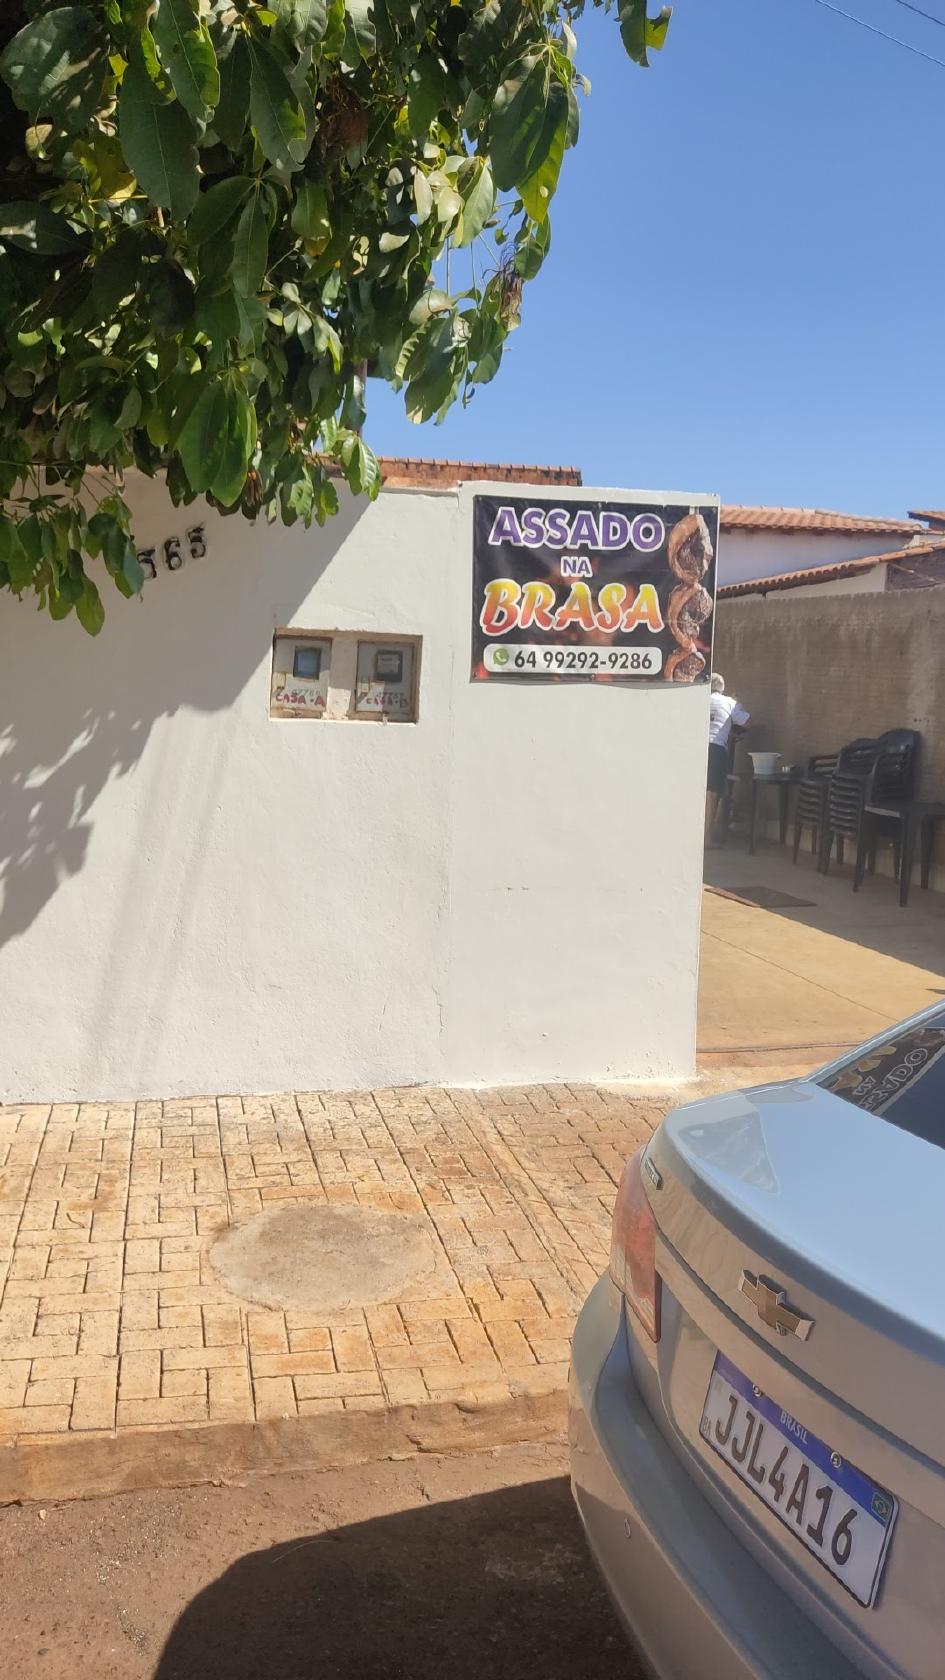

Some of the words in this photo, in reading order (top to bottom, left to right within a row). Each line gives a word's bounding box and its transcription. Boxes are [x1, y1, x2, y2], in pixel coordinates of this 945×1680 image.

[488, 507, 665, 552] ASSADO
[561, 556, 593, 577] NA
[480, 578, 665, 636] BRASA
[514, 650, 537, 669] 64
[543, 651, 653, 670] 99292-9286
[780, 1410, 809, 1445] BRASIL
[715, 1395, 858, 1566] JJL4A16
